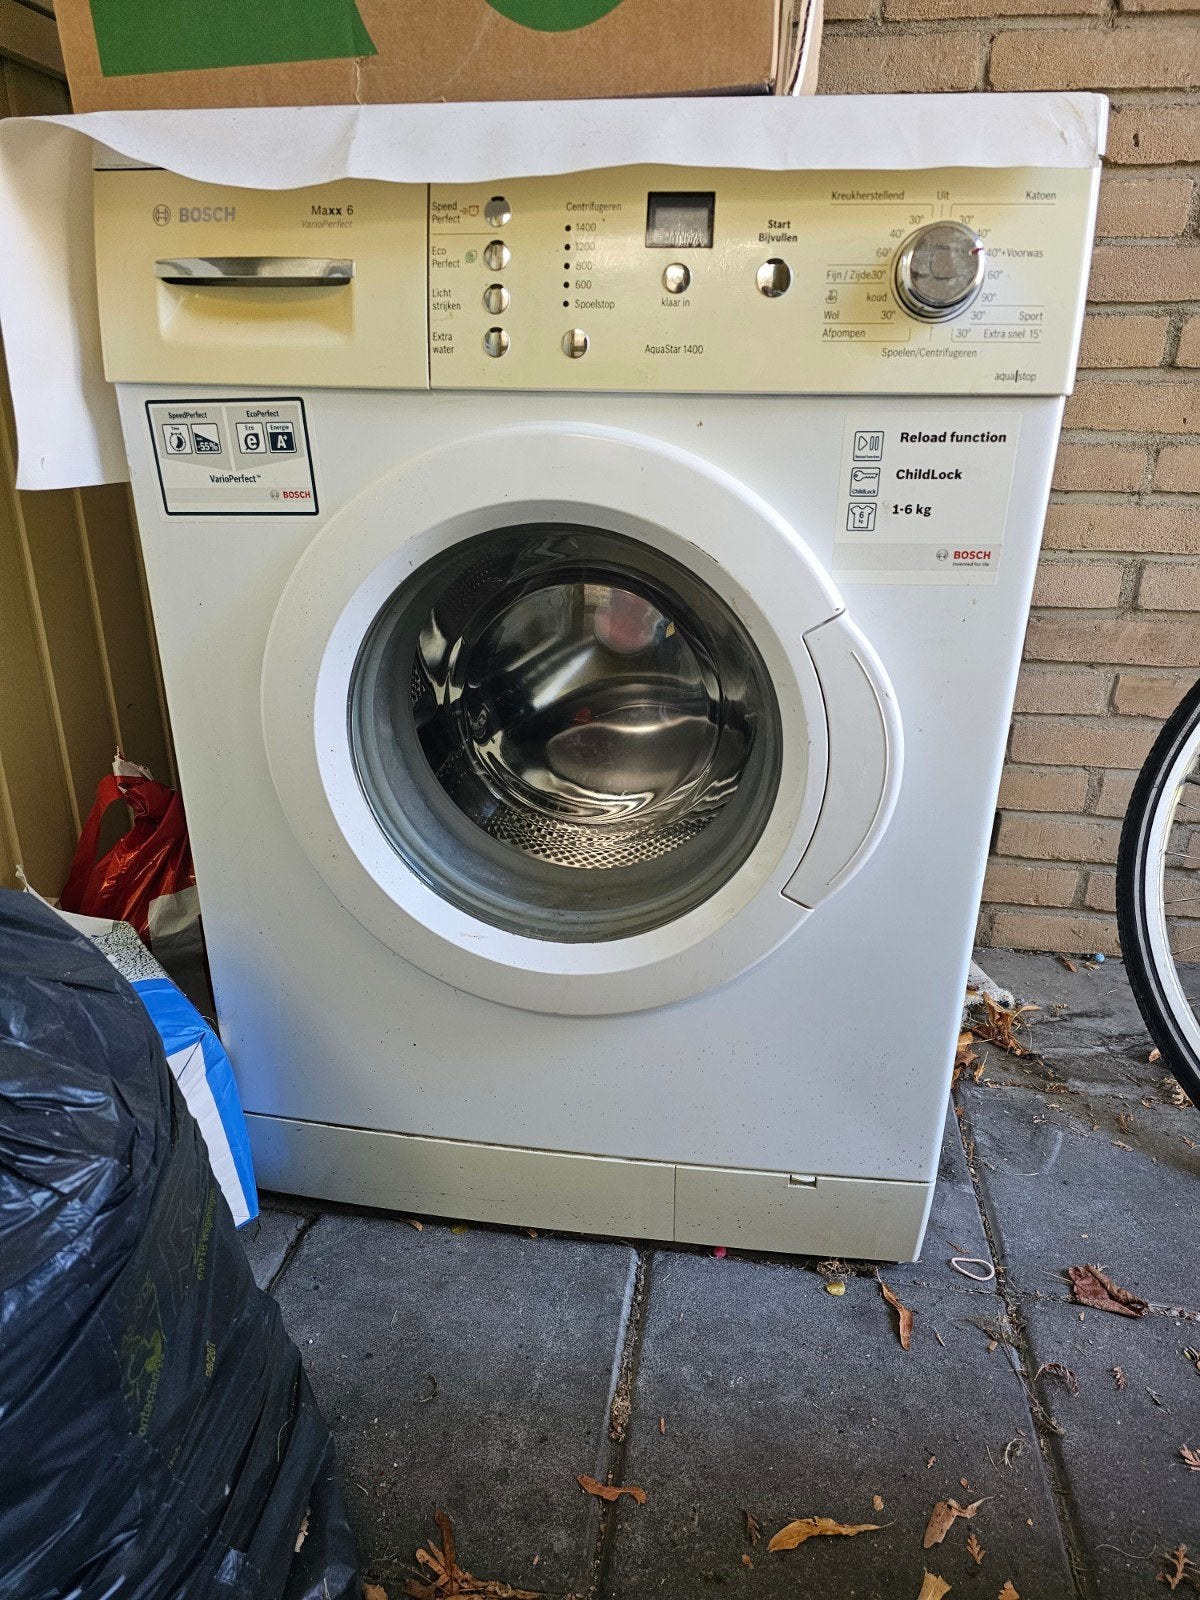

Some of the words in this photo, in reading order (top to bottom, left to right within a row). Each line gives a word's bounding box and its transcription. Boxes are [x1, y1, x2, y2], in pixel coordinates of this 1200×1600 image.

[831, 190, 905, 200] Kreukherstellend
[937, 191, 950, 200] Uit
[1025, 191, 1057, 200] Katoen
[311, 205, 342, 216] Maxx
[346, 204, 354, 216] 6
[432, 201, 458, 212] Speed
[566, 201, 622, 214] Centrifugeren
[179, 206, 236, 223] BOSCH
[432, 214, 461, 224] Perfect
[301, 219, 353, 229] VarioPerfect
[767, 219, 791, 229] Start
[908, 215, 925, 225] 30°
[575, 222, 597, 232] 1400
[758, 232, 798, 244] Bijvullen
[889, 229, 906, 239] 40°
[432, 246, 447, 256] Eco
[575, 242, 596, 251] 1200
[876, 248, 892, 258] 60°
[432, 259, 460, 269] Perfect
[575, 261, 593, 270] 800
[826, 270, 843, 281] Fijn
[987, 270, 1003, 280] 60°
[575, 280, 592, 289] 600
[432, 289, 451, 298] Licht
[866, 292, 888, 302] koud
[981, 292, 997, 302] 90°
[432, 301, 461, 312] strijken
[574, 299, 616, 310] Spoelstop
[661, 297, 682, 307] klaar
[682, 297, 691, 307] in
[823, 310, 840, 320] Wol
[880, 310, 896, 320] 30°
[970, 311, 986, 321] 30°
[1018, 311, 1044, 322] Sport
[432, 332, 453, 342] Extra
[822, 328, 866, 339] Afpompen
[956, 328, 971, 339] 30°
[983, 328, 1006, 339] Extra
[1008, 328, 1026, 339] snel
[432, 345, 455, 354] water
[645, 344, 682, 355] AquaStar
[683, 345, 704, 354] 1400
[882, 347, 978, 360] Spoelen/Centrifugeren
[168, 411, 208, 420] SpeedPerfect
[246, 410, 279, 418] EcoPerfect
[900, 432, 946, 443] Reload
[950, 431, 1007, 443] function
[896, 469, 963, 480] ChildLock
[282, 491, 311, 499] BOSCH
[859, 511, 865, 519] 6
[892, 504, 913, 515] 1-6
[915, 503, 932, 517] kg
[953, 550, 992, 560] BOSCH
